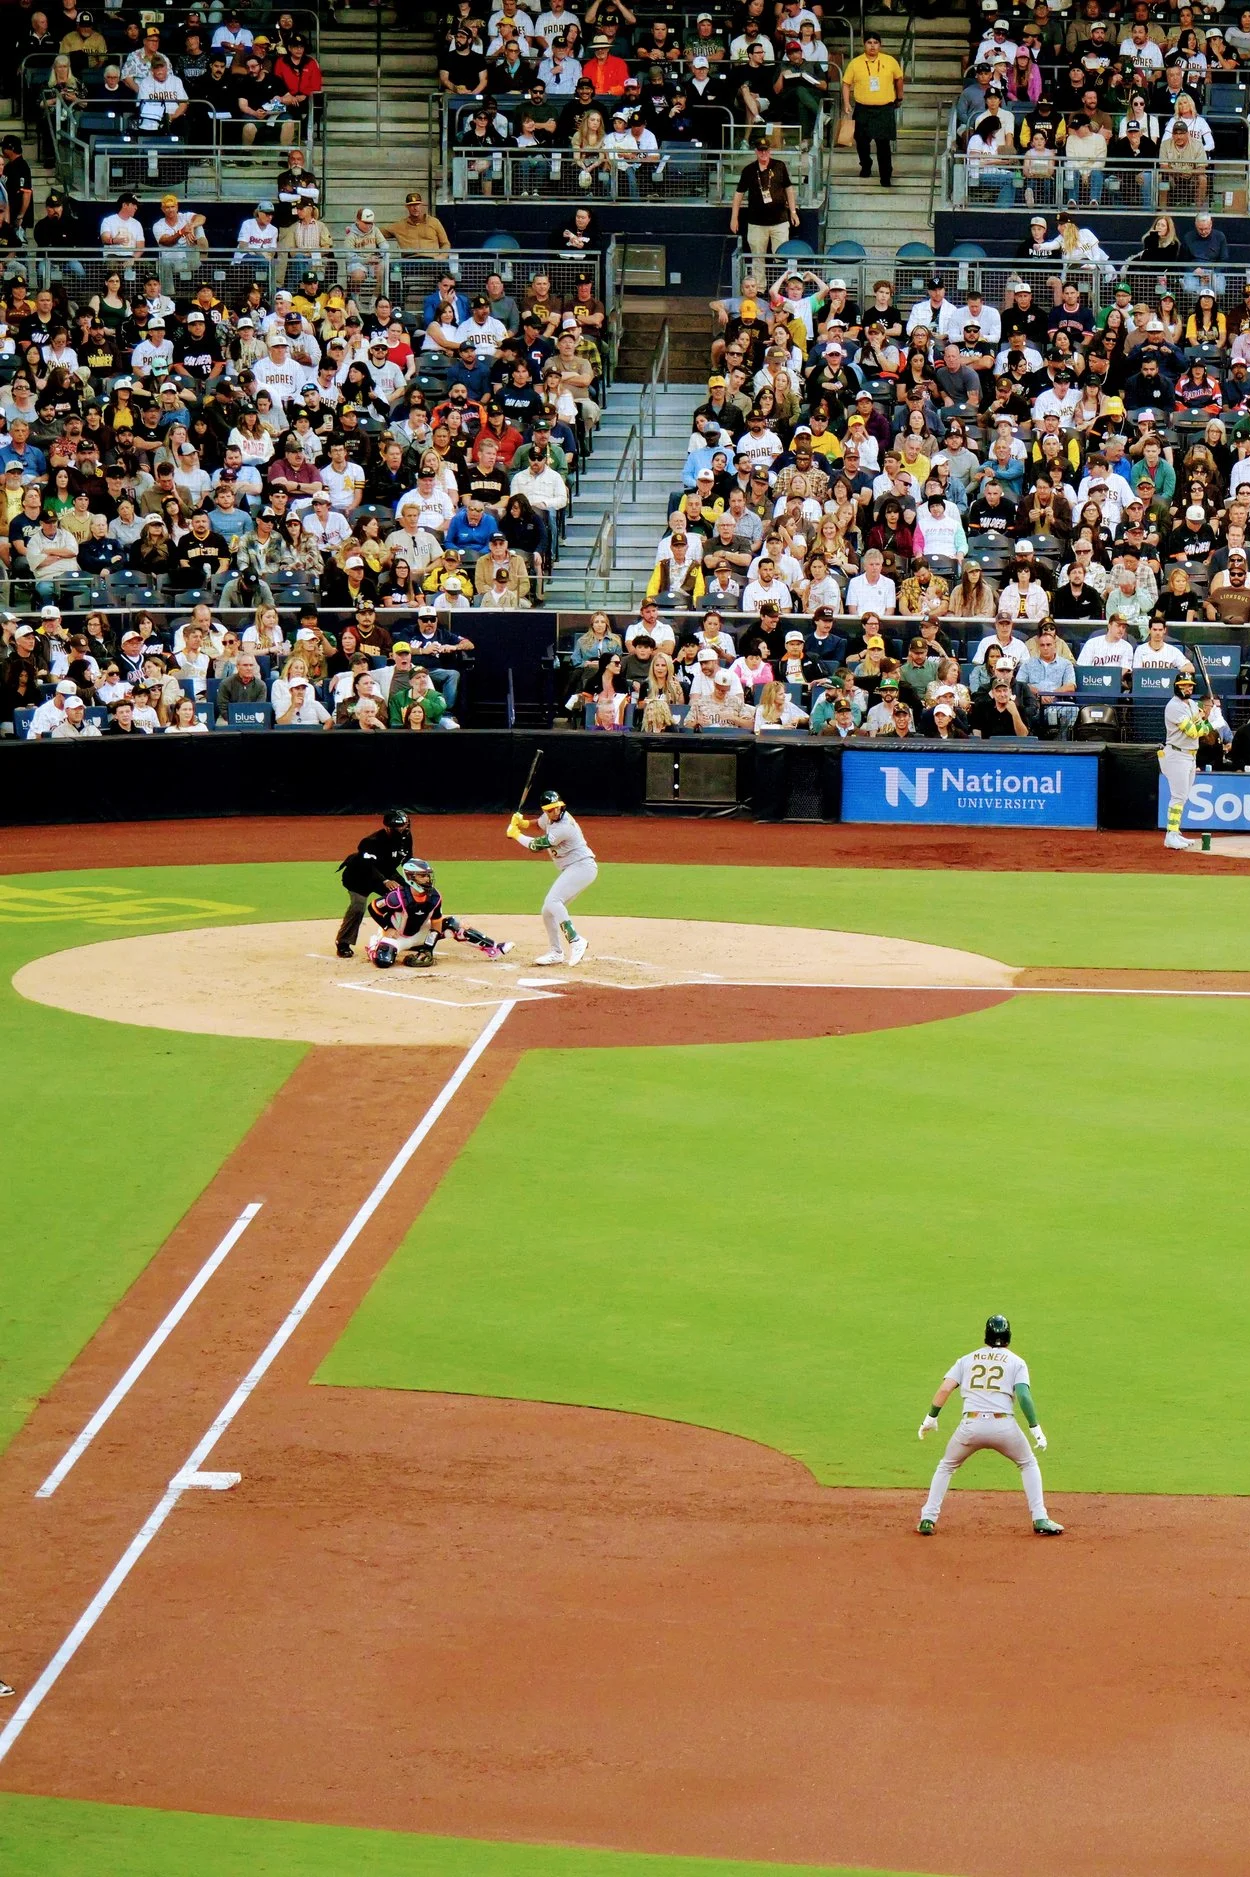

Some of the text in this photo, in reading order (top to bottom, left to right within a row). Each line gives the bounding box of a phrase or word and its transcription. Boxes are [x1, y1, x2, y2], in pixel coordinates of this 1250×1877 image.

[265, 375, 294, 385] PADRES
[1202, 656, 1222, 665] blue
[1082, 676, 1103, 685] blue
[1141, 676, 1162, 685] blue
[235, 712, 256, 721] blue
[942, 768, 1062, 794] National
[957, 797, 1046, 810] UNIVERSITY
[969, 1364, 1005, 1391] 22
